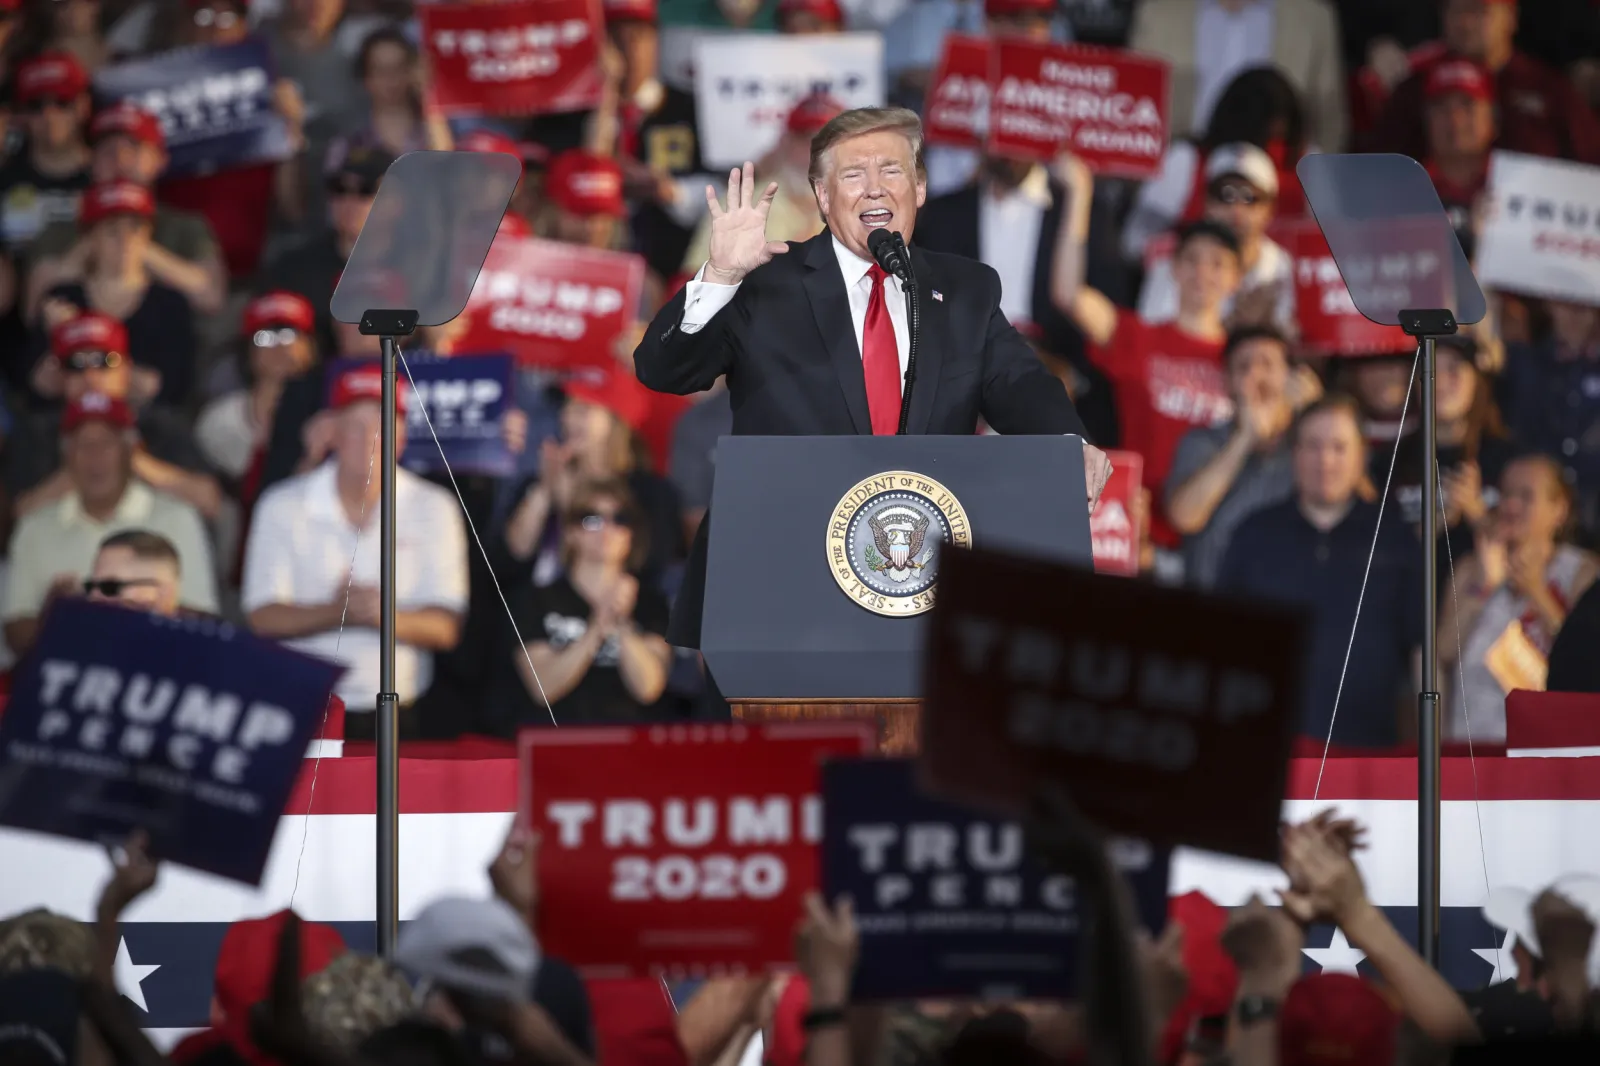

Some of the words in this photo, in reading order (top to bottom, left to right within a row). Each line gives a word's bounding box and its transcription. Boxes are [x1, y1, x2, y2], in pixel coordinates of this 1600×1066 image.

[1506, 194, 1600, 233] TRU
[900, 477, 913, 488] OF
[916, 480, 934, 496] THE
[832, 476, 896, 540] PRESIDENT
[833, 545, 844, 566] THE
[838, 568, 851, 580] OF
[850, 579, 886, 609] SEAL
[39, 658, 296, 750] TRUMP
[37, 709, 251, 784] PENCE
[611, 853, 788, 900] 2020
[873, 874, 1076, 910] PENC
